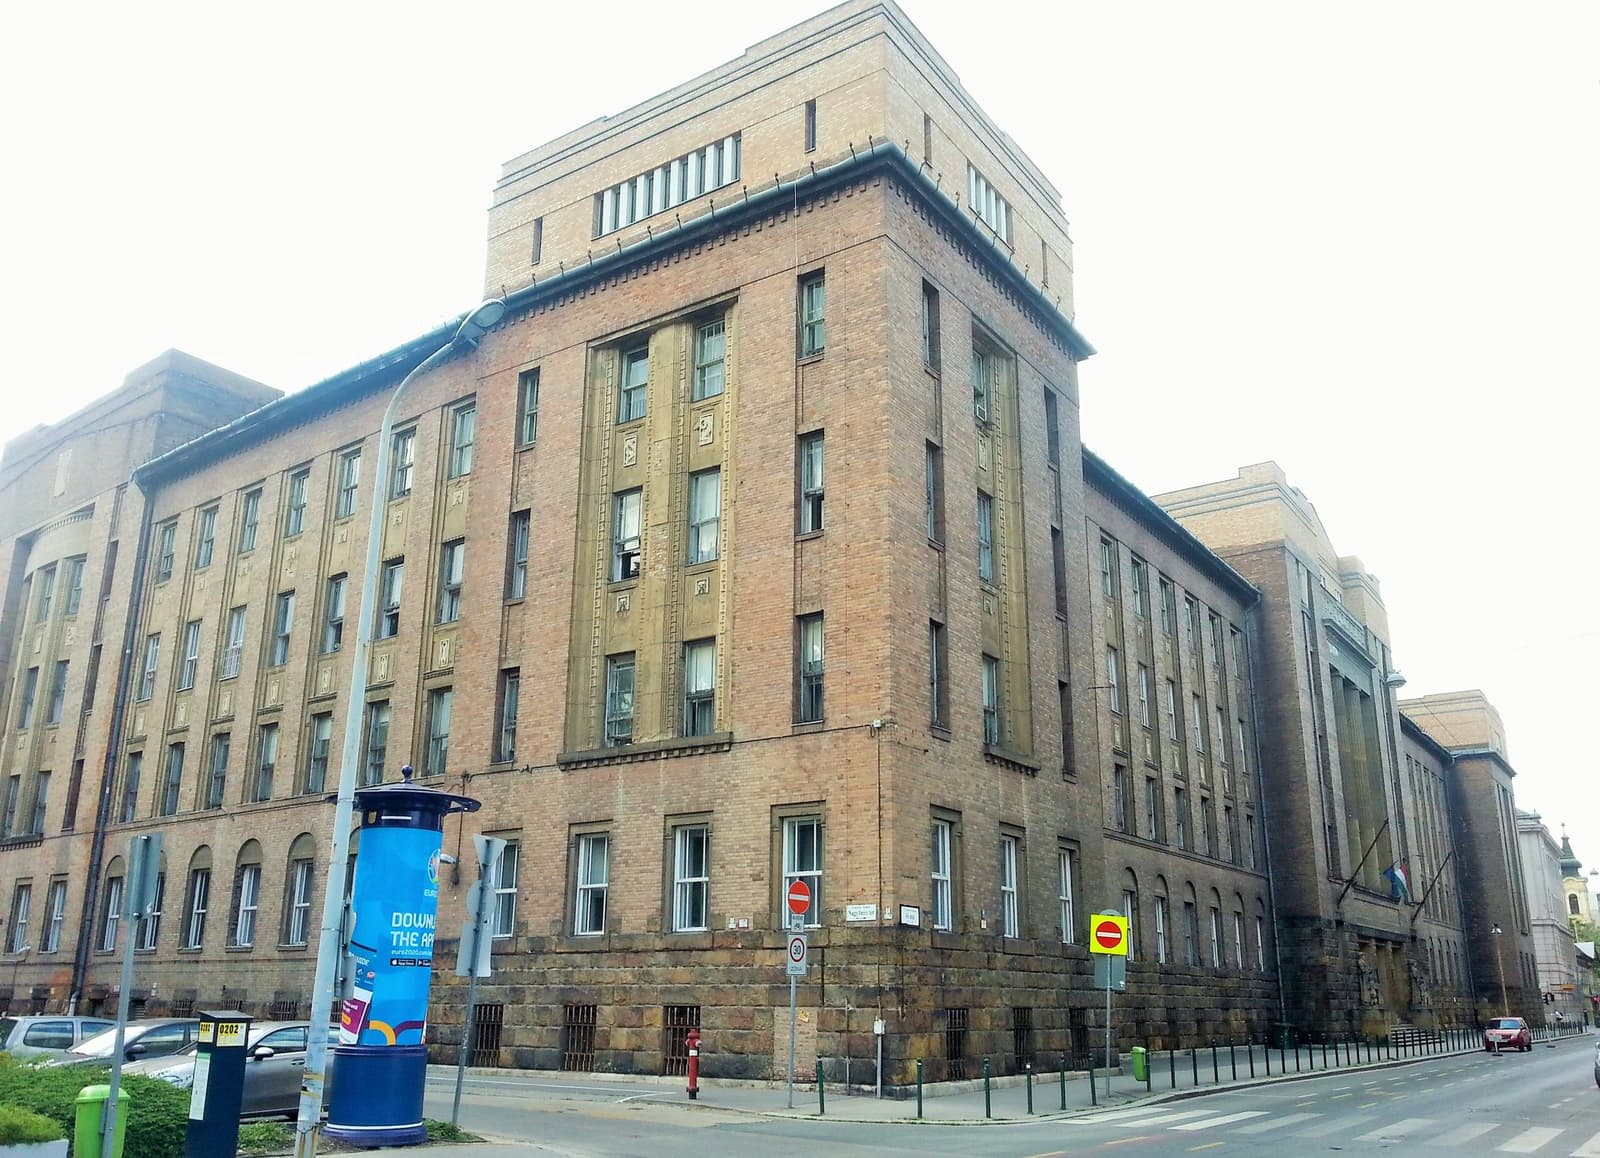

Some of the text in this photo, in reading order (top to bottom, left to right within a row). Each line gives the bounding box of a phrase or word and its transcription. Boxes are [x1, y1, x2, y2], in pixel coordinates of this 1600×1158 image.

[390, 931, 420, 947] THE
[793, 945, 802, 955] 30
[219, 1024, 239, 1034] 0202
